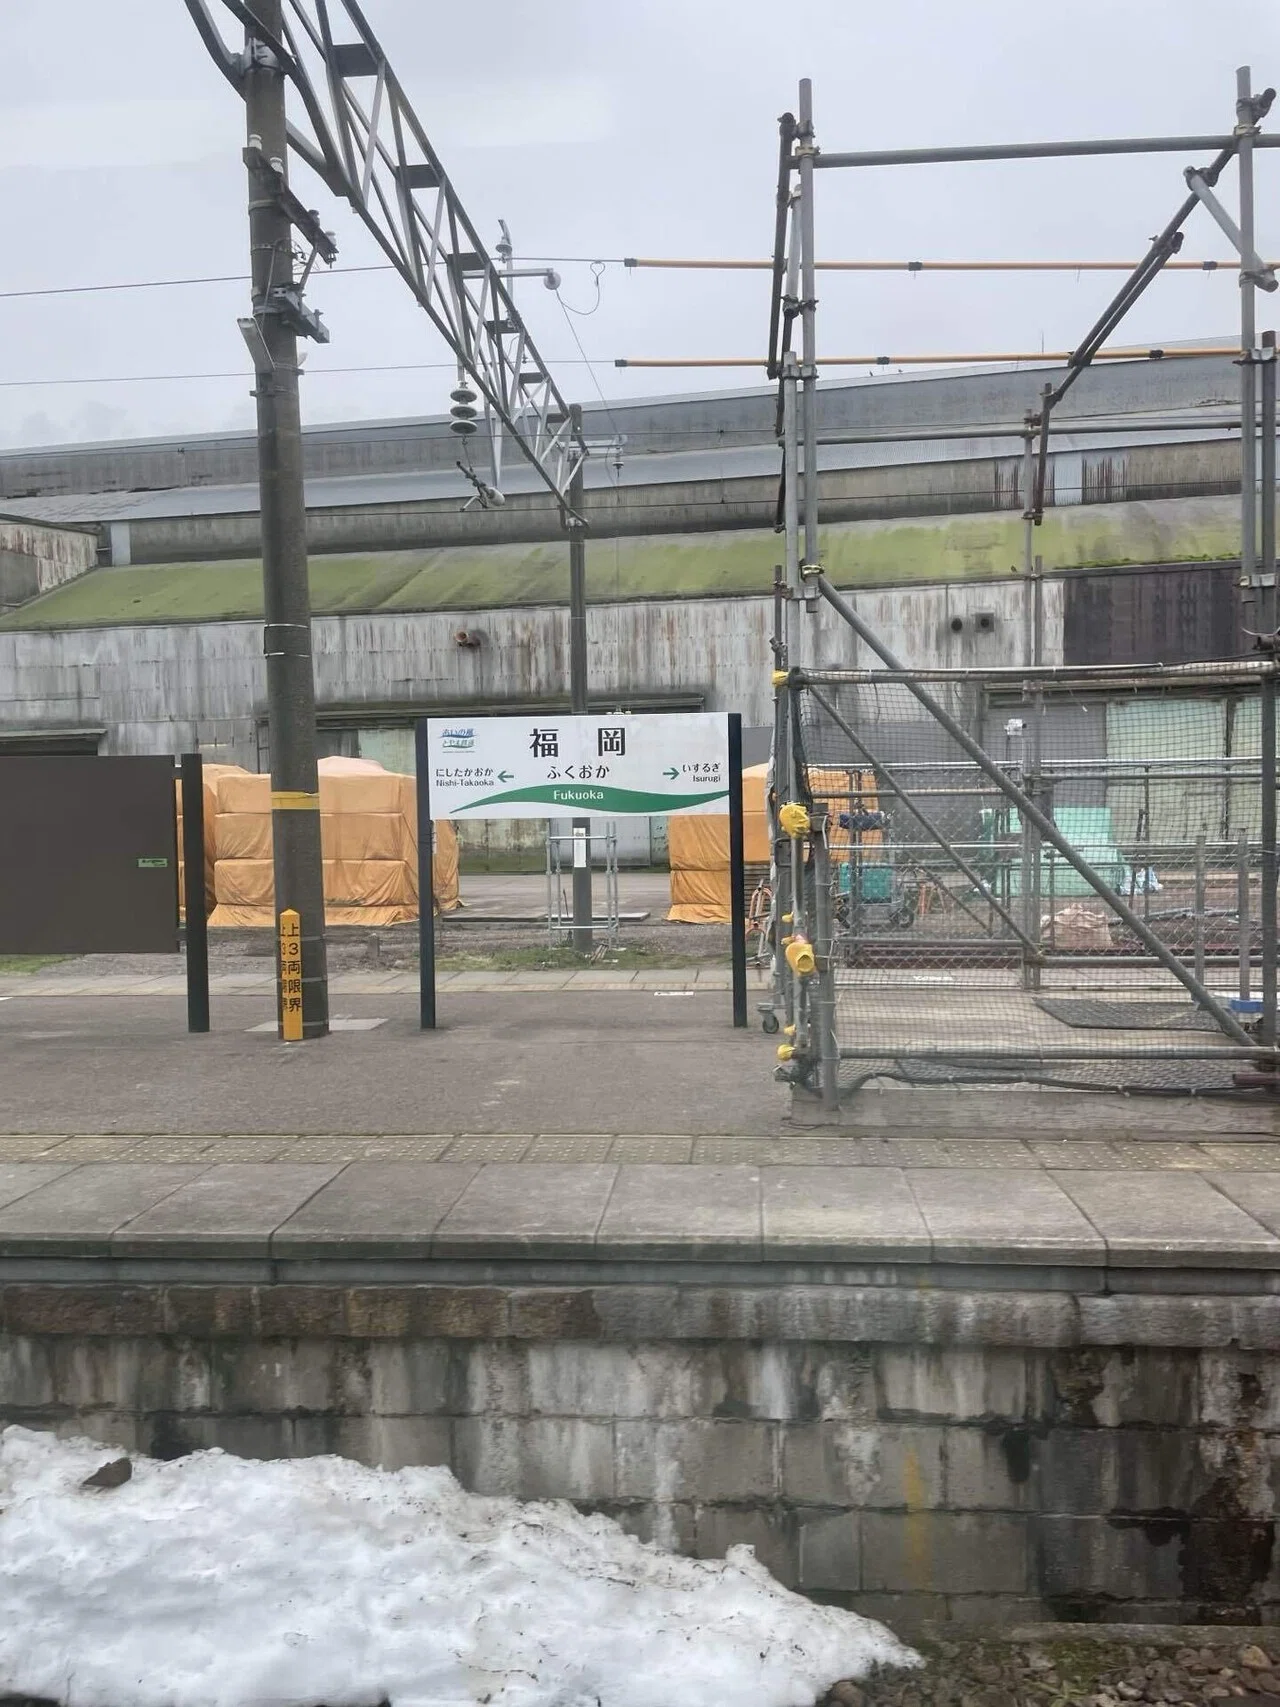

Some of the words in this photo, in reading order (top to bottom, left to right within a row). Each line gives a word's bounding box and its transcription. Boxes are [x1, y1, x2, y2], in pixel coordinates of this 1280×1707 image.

[529, 728, 626, 758] 福岡
[435, 767, 494, 777] にしたかおか
[547, 764, 610, 779] ふくおか
[682, 763, 721, 773] いするぎ
[435, 779, 495, 787] Nishi-Takaoka
[692, 775, 721, 783] Isurugi
[553, 790, 604, 800] Fukuoka
